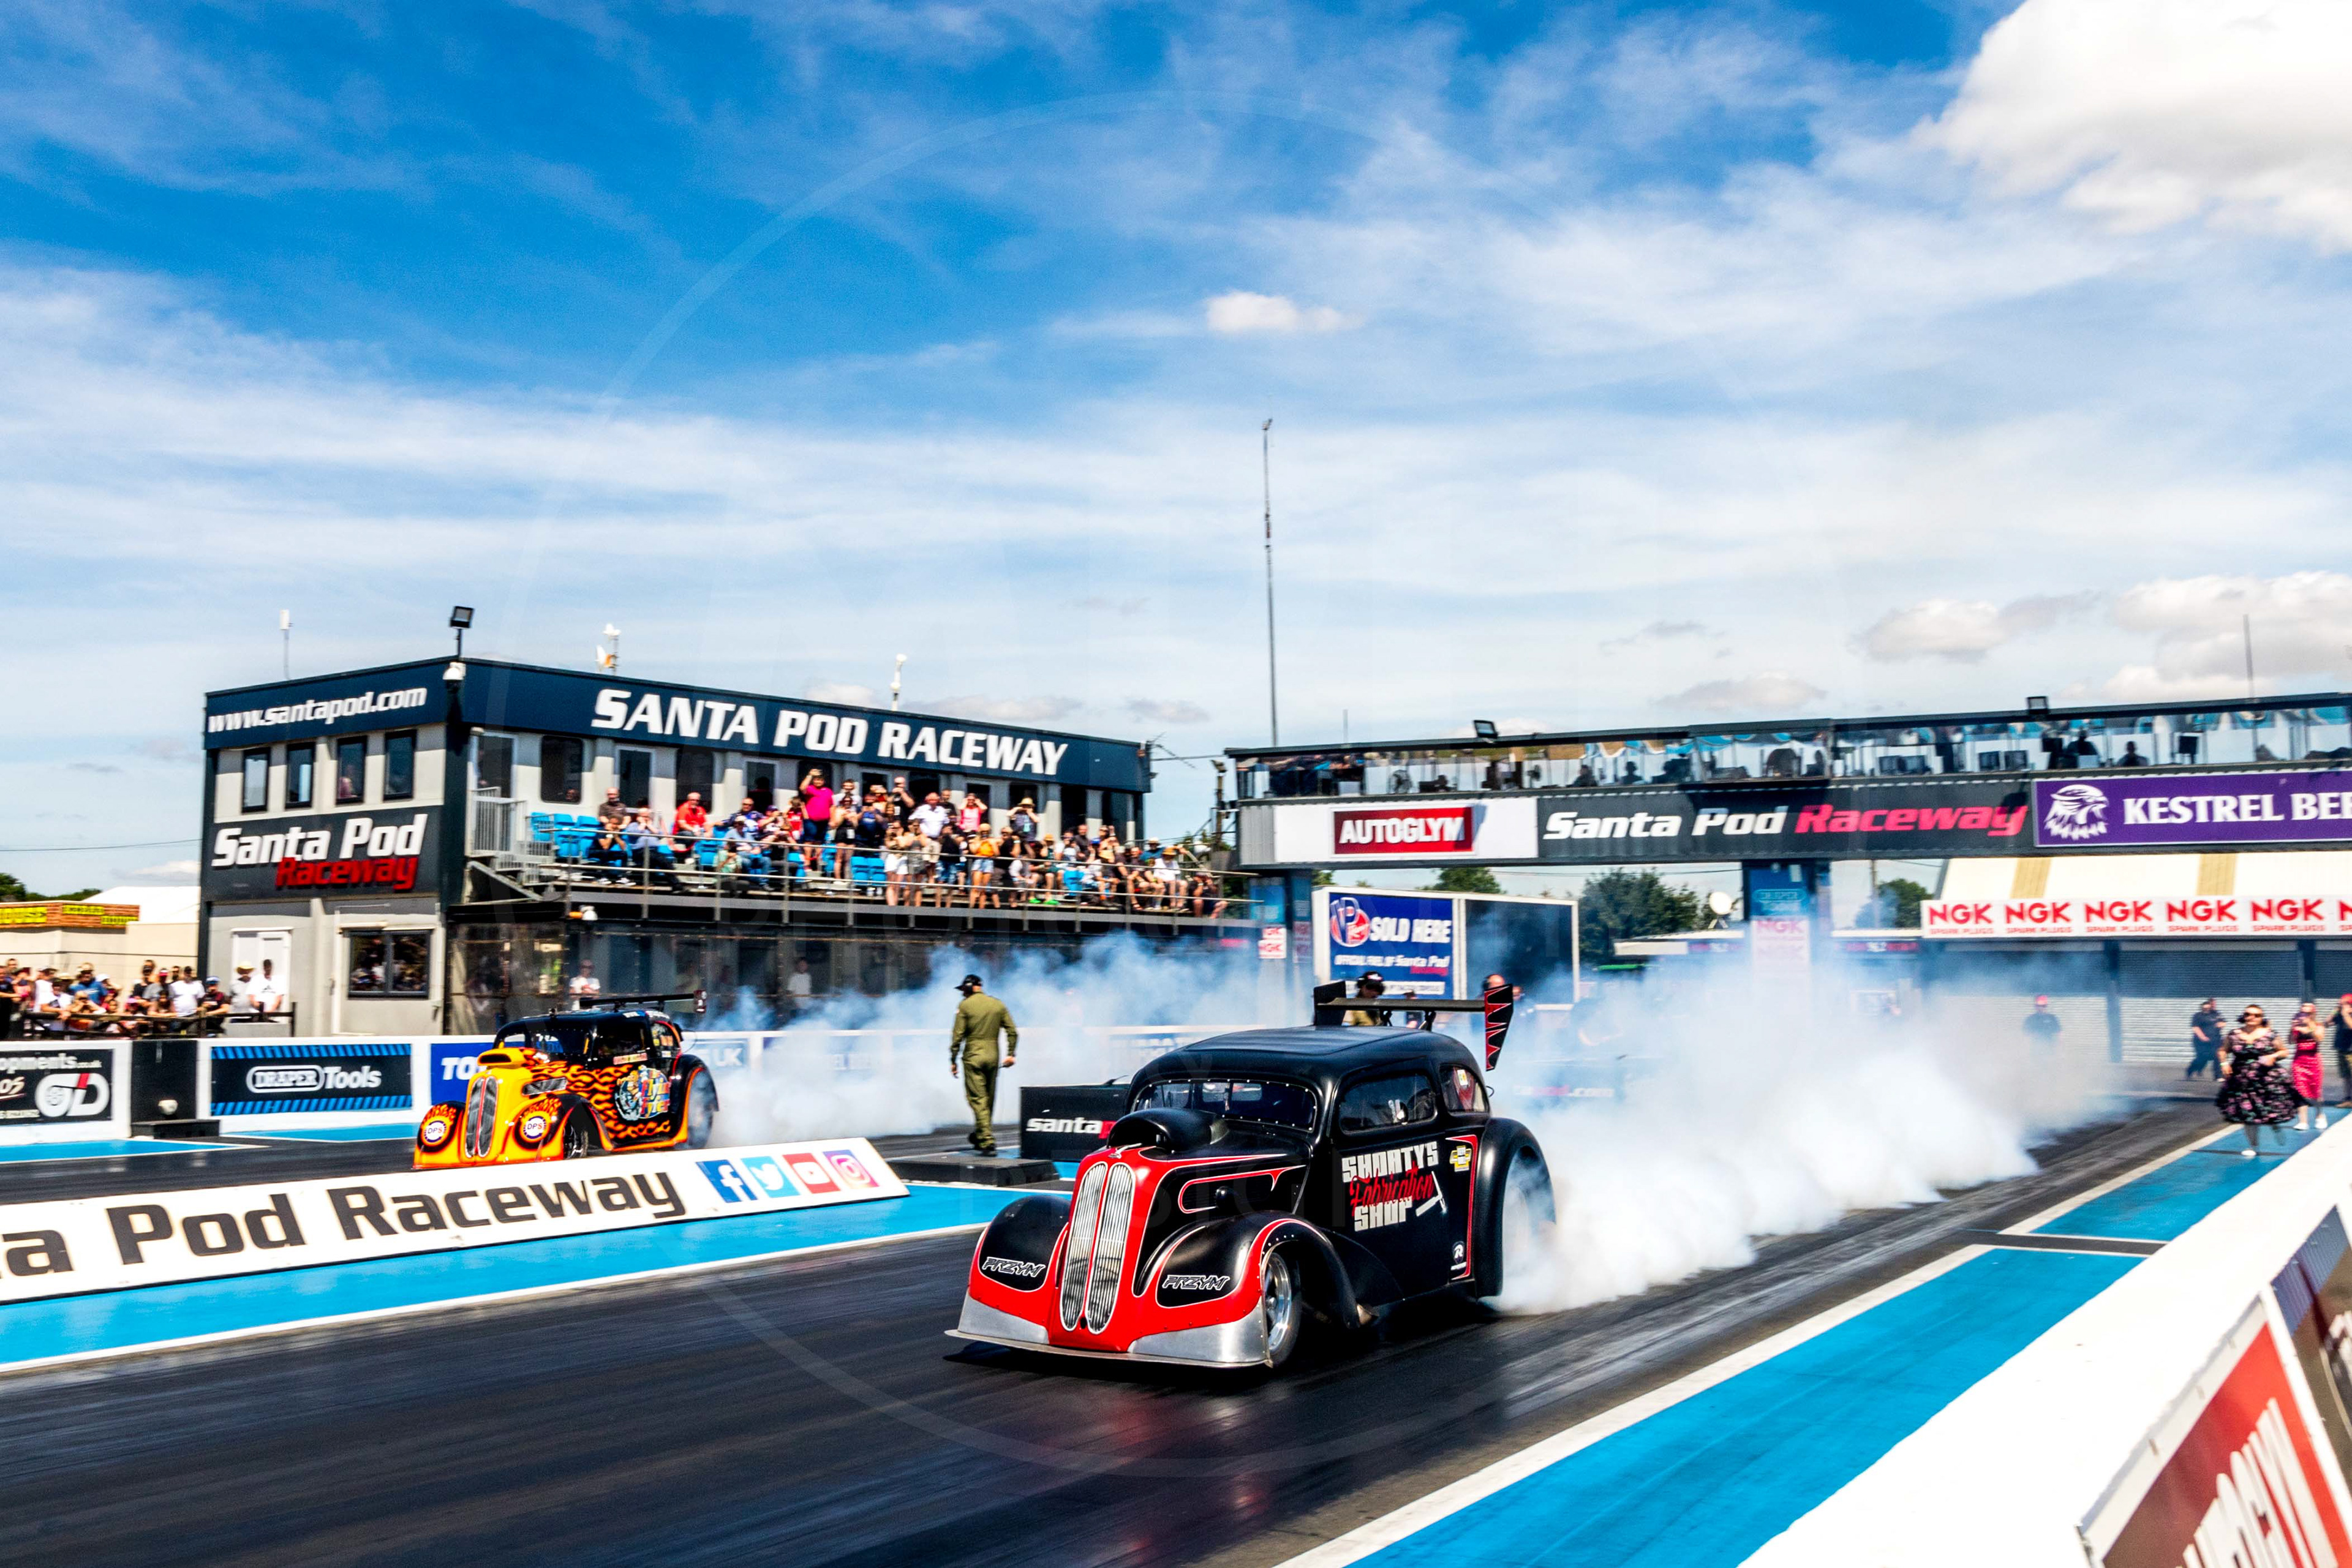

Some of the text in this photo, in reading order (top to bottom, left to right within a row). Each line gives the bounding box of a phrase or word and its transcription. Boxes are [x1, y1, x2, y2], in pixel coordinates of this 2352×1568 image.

[208, 687, 428, 734] www.santapod.com
[590, 688, 1068, 776] SANTA POD RACEWAY
[1543, 804, 2029, 840] Santa Pod Raceway
[2124, 794, 2285, 825] KESTREL
[211, 813, 428, 867] Santa Pod
[1339, 817, 1465, 845] AUTOGLYM
[275, 856, 419, 891] Raceway
[1370, 916, 1410, 942] SOLD
[1411, 919, 1452, 943] HERE
[1929, 903, 1992, 925] NGK
[2005, 902, 2071, 924] NGK
[2084, 900, 2153, 923] NGK
[2166, 900, 2237, 922] NGK
[2251, 899, 2324, 921] NGK
[323, 1065, 382, 1088] Tools
[105, 1193, 307, 1265] Pod
[326, 1172, 686, 1240] Raceway
[1354, 1196, 1413, 1232] SHOP
